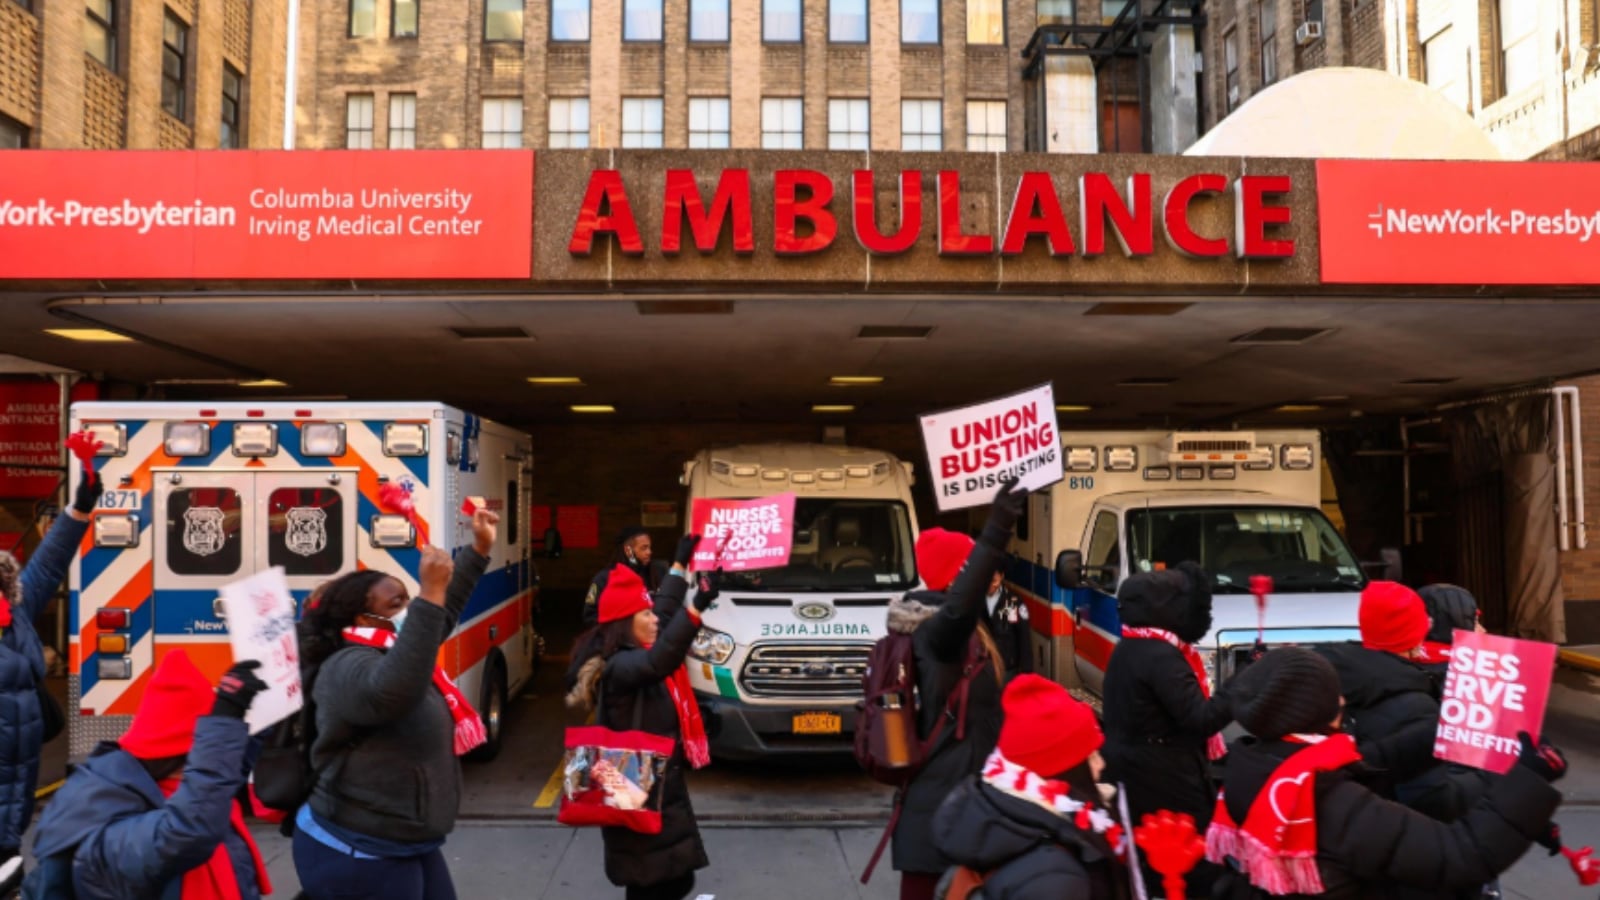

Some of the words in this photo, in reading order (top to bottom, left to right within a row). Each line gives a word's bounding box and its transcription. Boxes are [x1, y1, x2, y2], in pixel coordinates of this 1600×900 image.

[249, 188, 354, 209] Columbia
[361, 188, 472, 213] University
[568, 168, 1296, 258] AMBULANCE
[249, 215, 311, 241] Irving
[317, 215, 401, 235] Medical
[408, 215, 482, 235] Center
[0, 414, 56, 425] NTRANCE
[8, 404, 60, 413] AMBULA
[951, 401, 1038, 450] UNION
[940, 422, 1053, 478] BUSTING
[944, 482, 960, 497] IS
[965, 449, 1055, 492] DISGUSTING
[1069, 476, 1094, 490] 810
[98, 490, 137, 508] 1871
[711, 503, 779, 523] NURSES
[704, 518, 782, 538] DESERVE
[1449, 646, 1520, 681] SES
